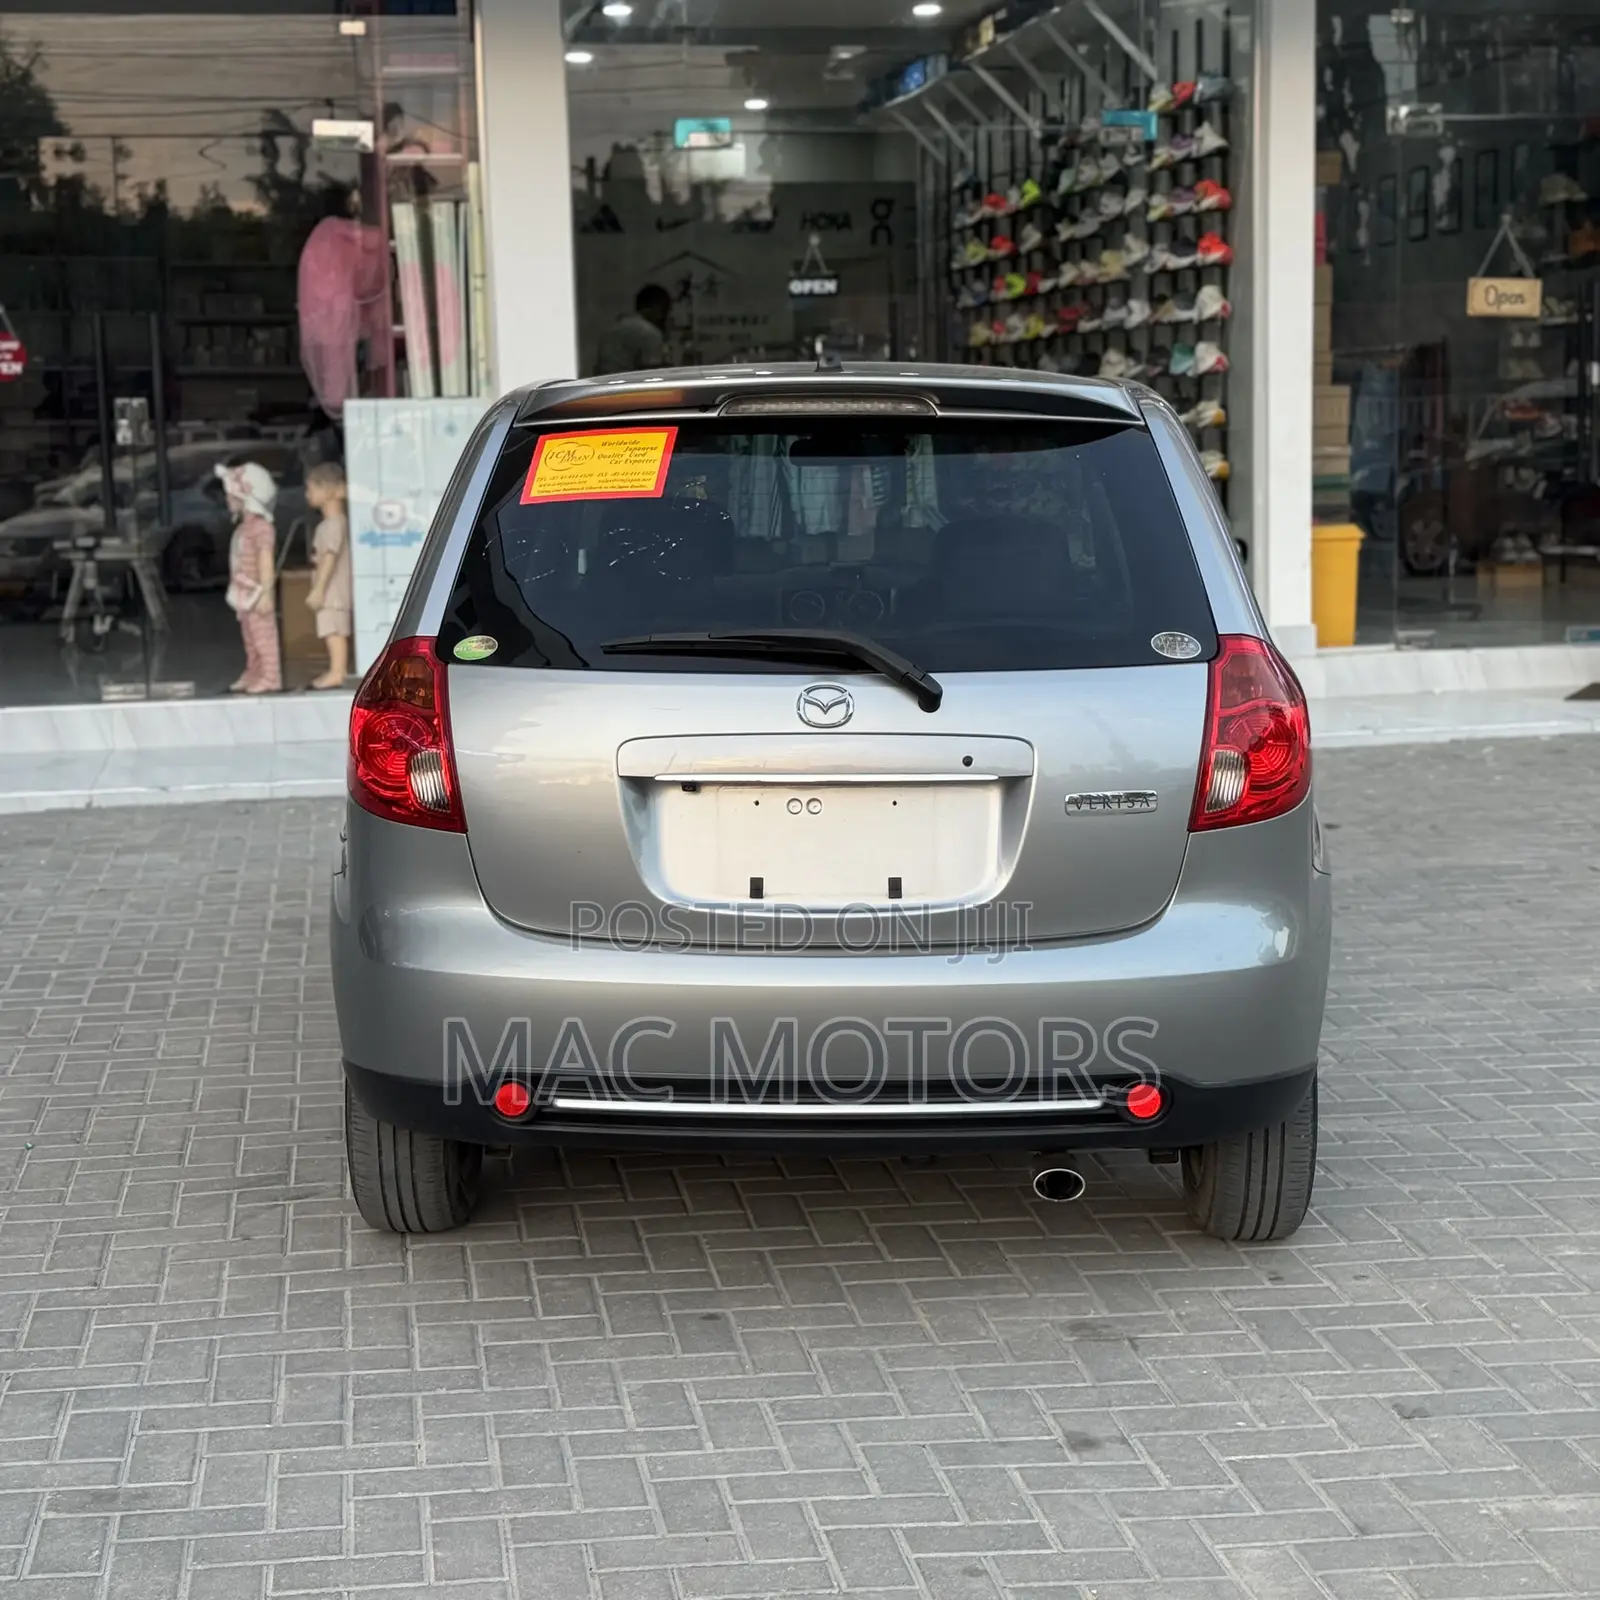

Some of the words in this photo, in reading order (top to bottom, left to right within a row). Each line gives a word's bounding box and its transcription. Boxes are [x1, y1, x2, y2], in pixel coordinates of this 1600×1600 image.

[788, 279, 838, 295] OPEN
[1484, 284, 1526, 311] Open
[601, 439, 641, 447] Worldwide
[597, 452, 624, 460] Quality
[624, 458, 658, 466] Exporter
[1071, 794, 1151, 811] VERISA
